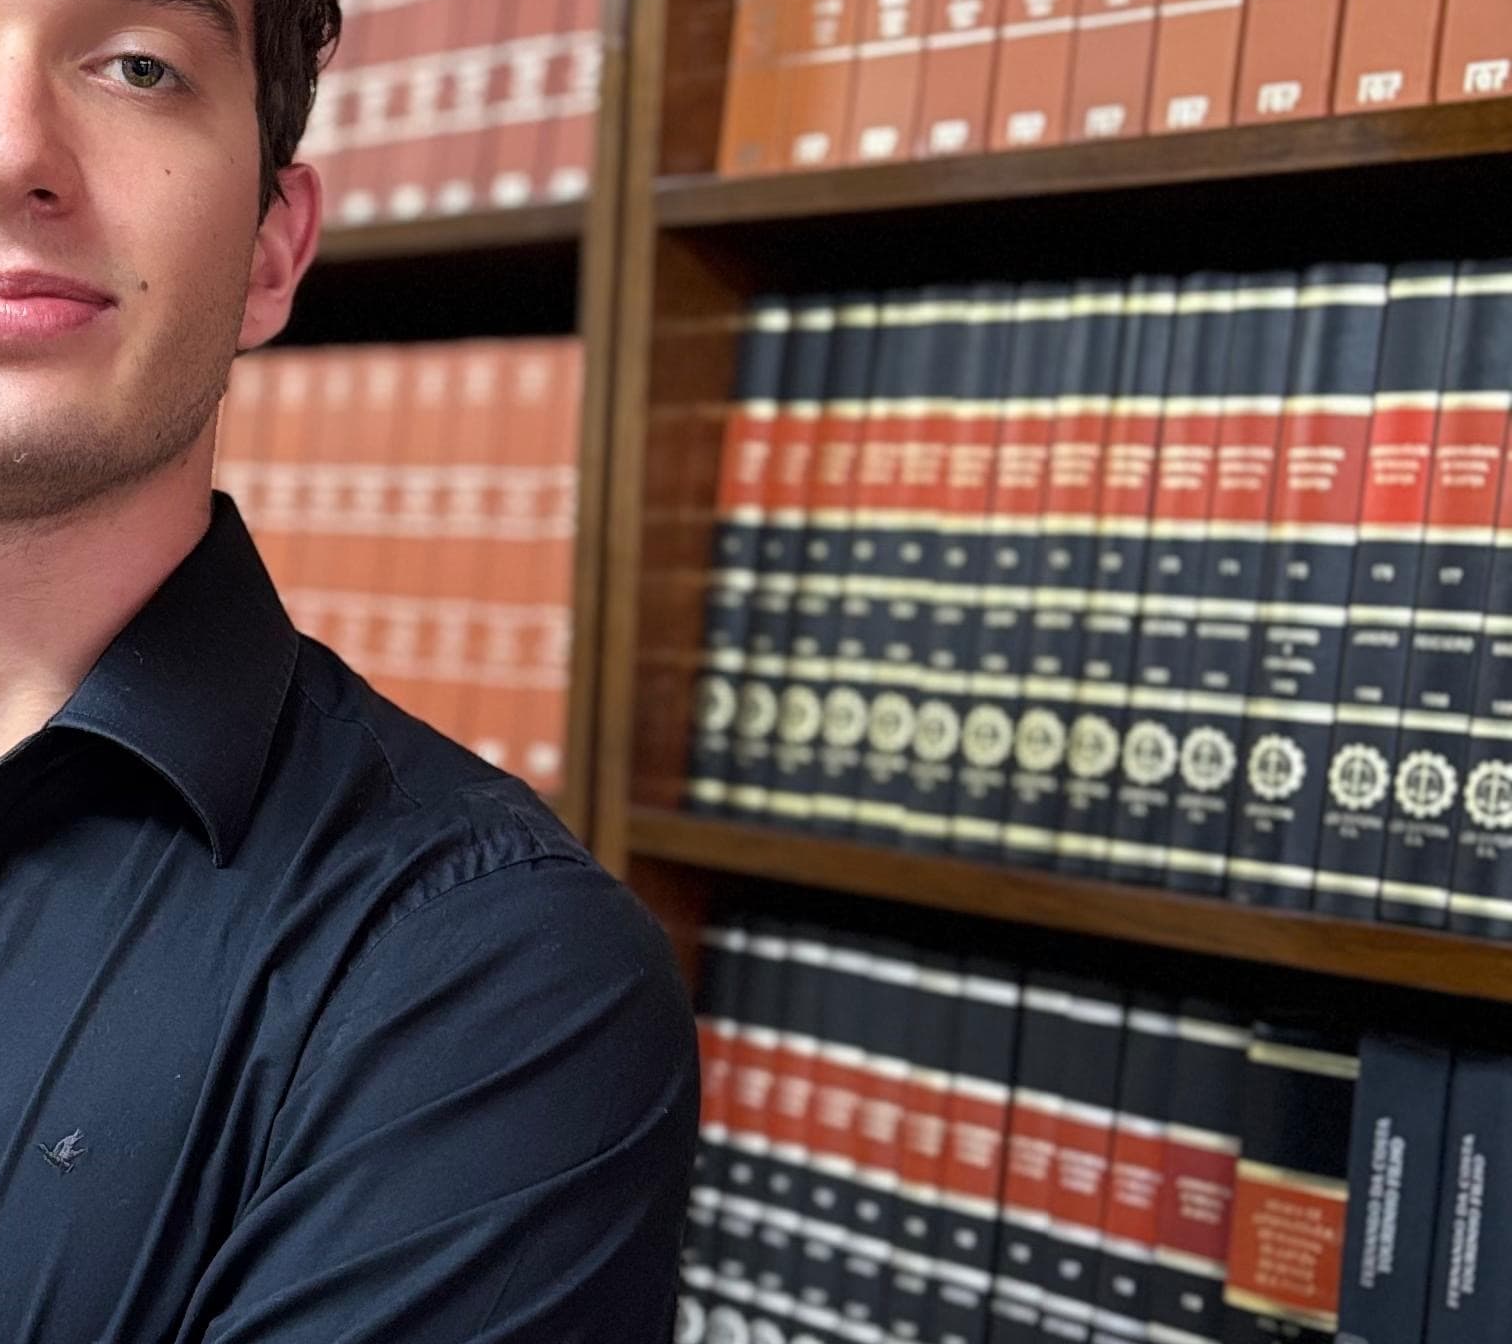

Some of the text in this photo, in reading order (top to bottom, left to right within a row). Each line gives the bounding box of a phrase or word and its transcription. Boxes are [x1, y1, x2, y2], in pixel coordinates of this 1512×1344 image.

[1359, 1116, 1392, 1290] FERNANDO DA COSTA
[1377, 1135, 1407, 1275] TOURINHO FILHO
[1446, 1133, 1476, 1310] FERNANDO DA COSTA
[1460, 1153, 1486, 1295] TOURINHO FILHO
